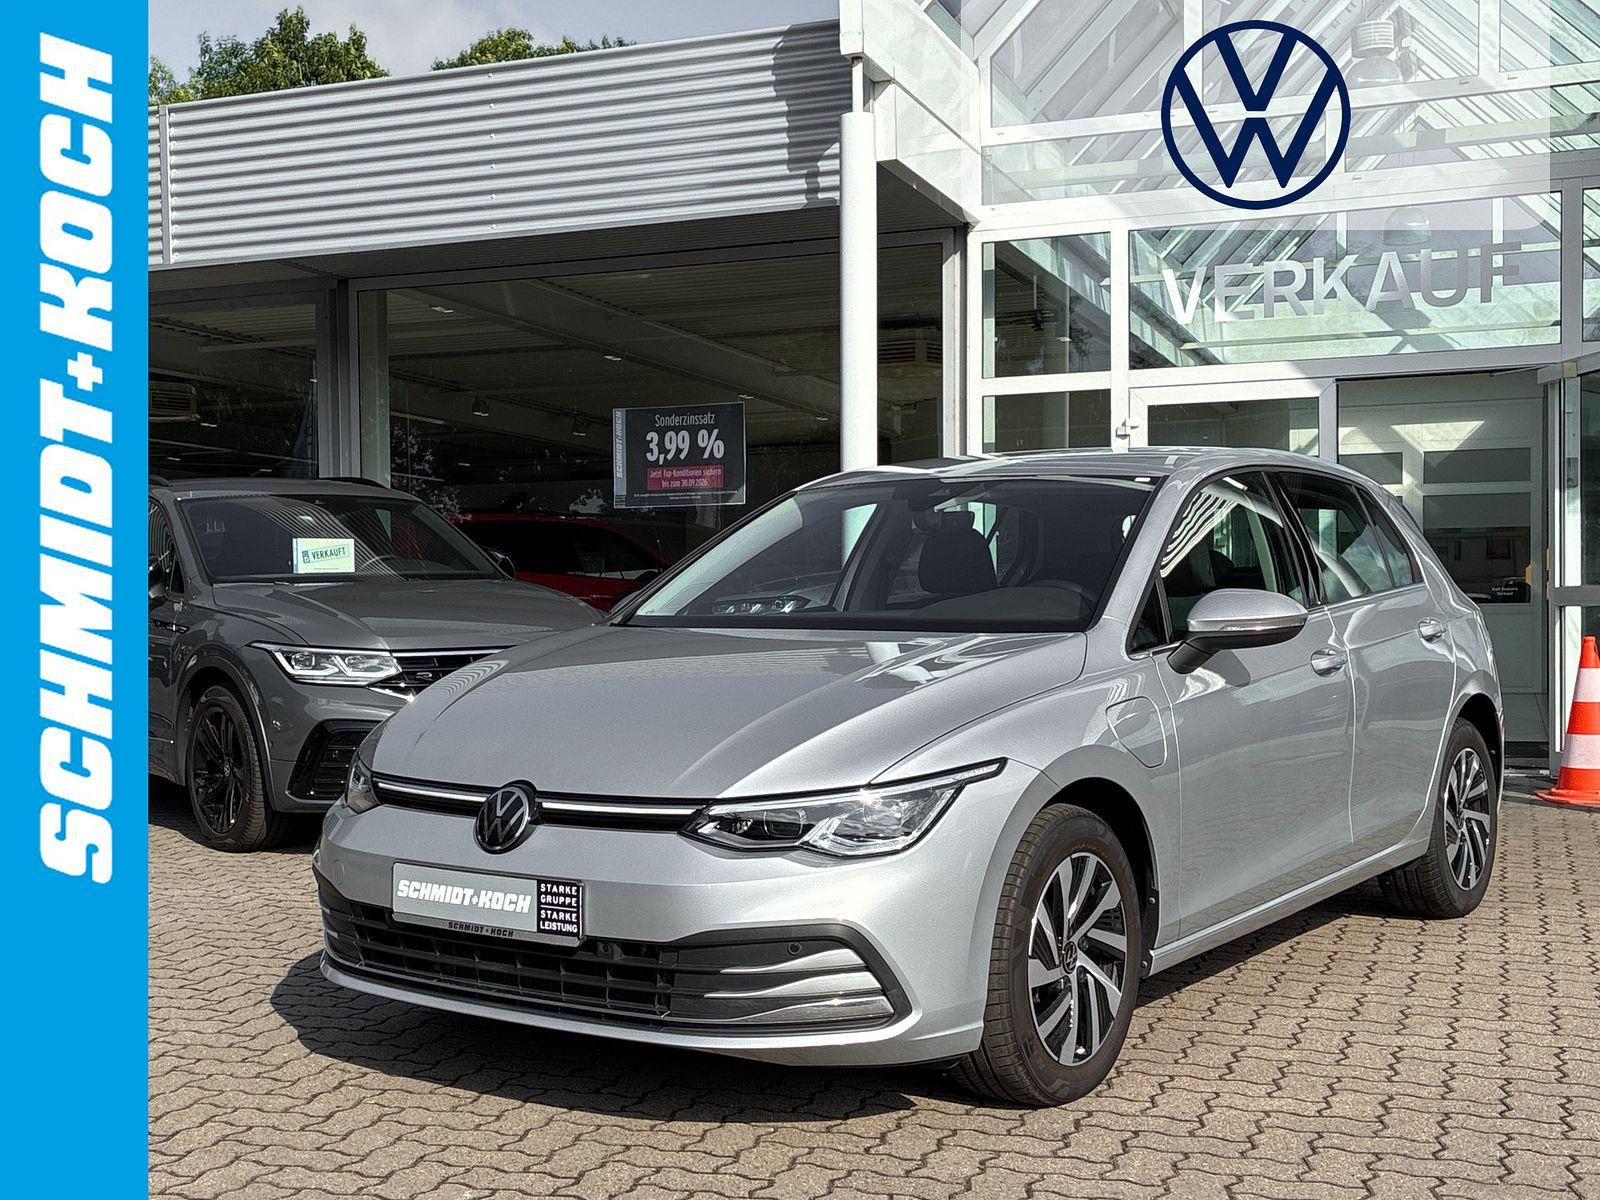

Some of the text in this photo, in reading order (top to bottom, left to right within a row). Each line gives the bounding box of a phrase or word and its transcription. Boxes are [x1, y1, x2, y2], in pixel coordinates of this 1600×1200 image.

[1161, 240, 1523, 326] VERKAUF
[655, 412, 715, 427] Sonderzinssatz
[645, 429, 725, 466] 3,99 %
[311, 547, 346, 560] VERKAUFT
[540, 883, 578, 896] STARKE
[397, 880, 532, 914] SCHMIDT+KOCH
[540, 896, 578, 907] GRUPPE
[540, 910, 578, 922] STARKE
[448, 921, 485, 934] SCHMIDT
[490, 928, 514, 938] KOCH
[539, 921, 578, 933] LEISTUNG
